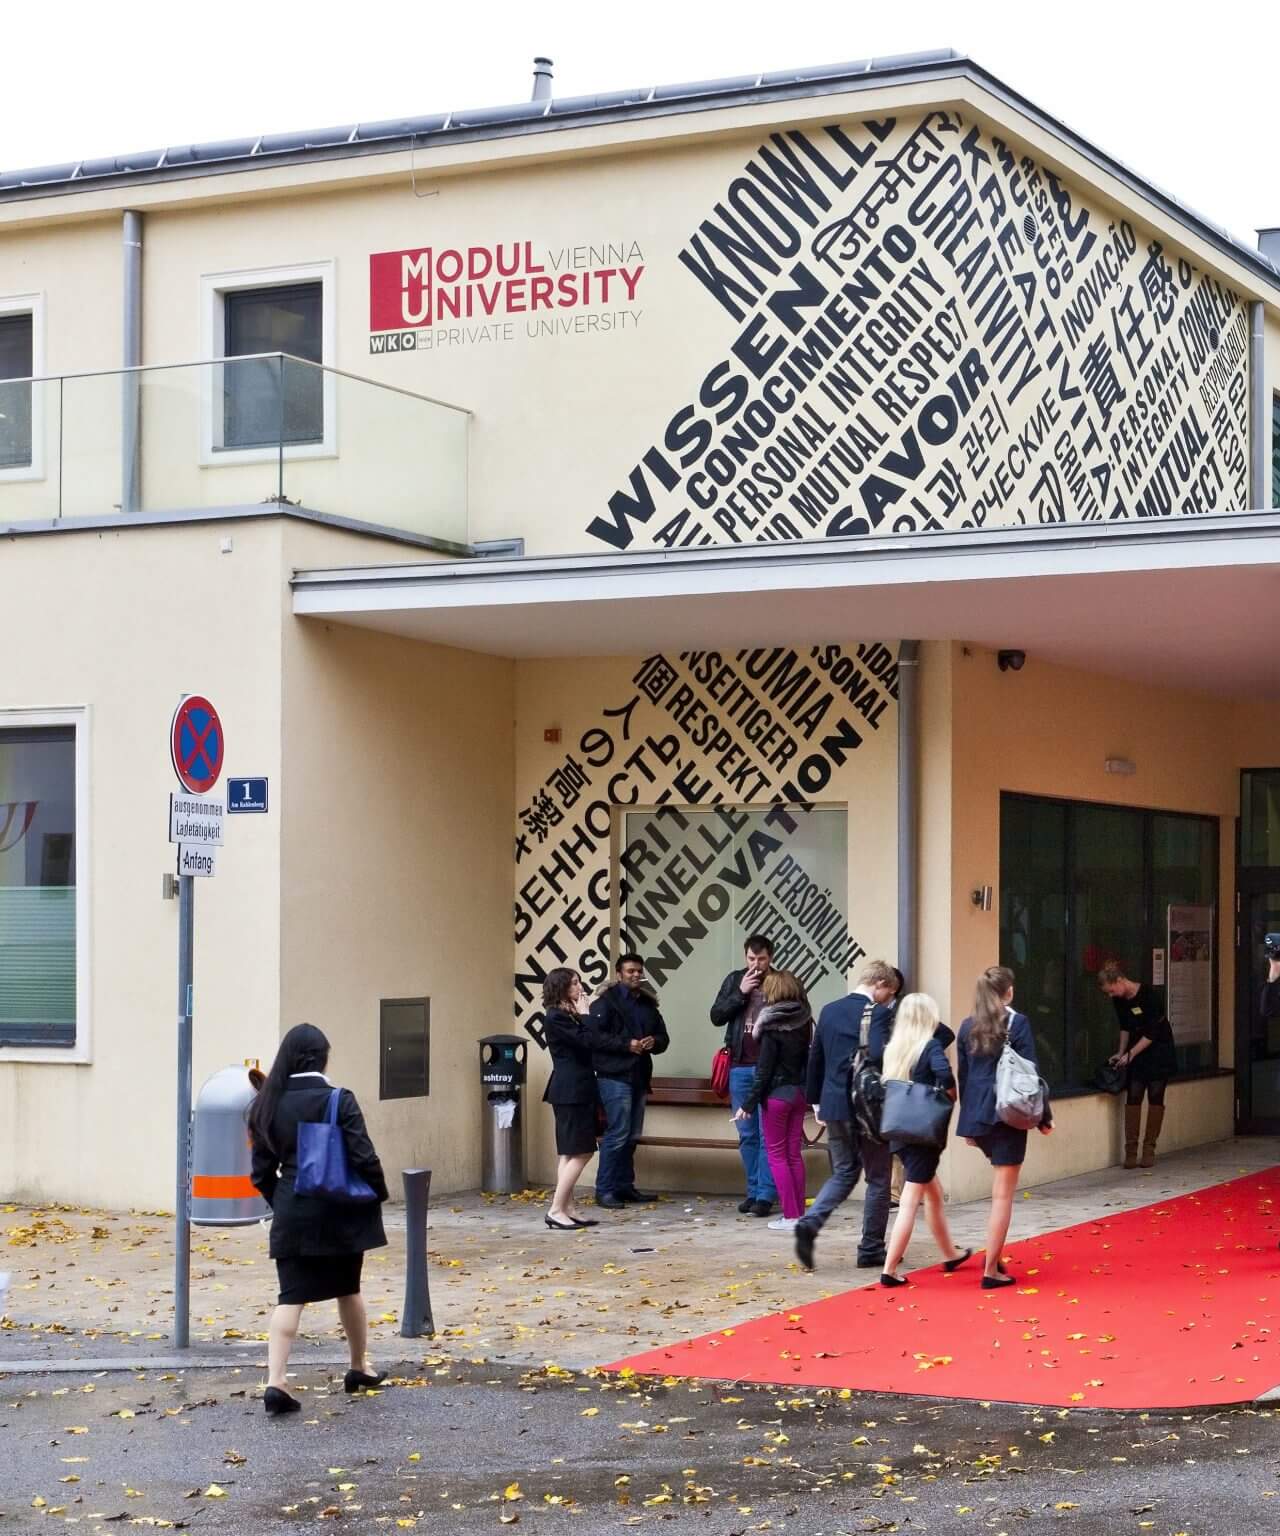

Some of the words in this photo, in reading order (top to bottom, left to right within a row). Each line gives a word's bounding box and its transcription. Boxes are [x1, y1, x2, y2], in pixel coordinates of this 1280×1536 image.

[549, 241, 643, 271] VIENNA
[908, 154, 1041, 405] CREATIVITY
[991, 136, 1061, 300] MUUO
[1020, 156, 1074, 284] RESPETO
[370, 332, 416, 354] WKO
[437, 323, 513, 347] PRIVATE
[527, 310, 643, 338] UNIVERSITY
[1060, 219, 1136, 350] INOVAÇÃO
[585, 261, 829, 550] WISSEN
[686, 224, 916, 509] CONOCIMIENTO
[713, 401, 836, 542] PERSONAL
[818, 258, 945, 414] INTEGRITY
[788, 413, 889, 528] MUTUAL
[872, 296, 968, 426] RESPECT
[1110, 337, 1180, 464] PERSONAL
[1121, 362, 1189, 494] INTEGRITY
[826, 348, 989, 537] SAVOIR
[1135, 405, 1209, 518] MUTUAL
[665, 684, 770, 803] RESPEKT
[811, 643, 888, 729] SONAL
[174, 800, 222, 817] ausgenommen
[243, 782, 252, 800] 1
[645, 717, 863, 993] NNOVATION
[515, 759, 712, 1015] NTÉGRITÉ
